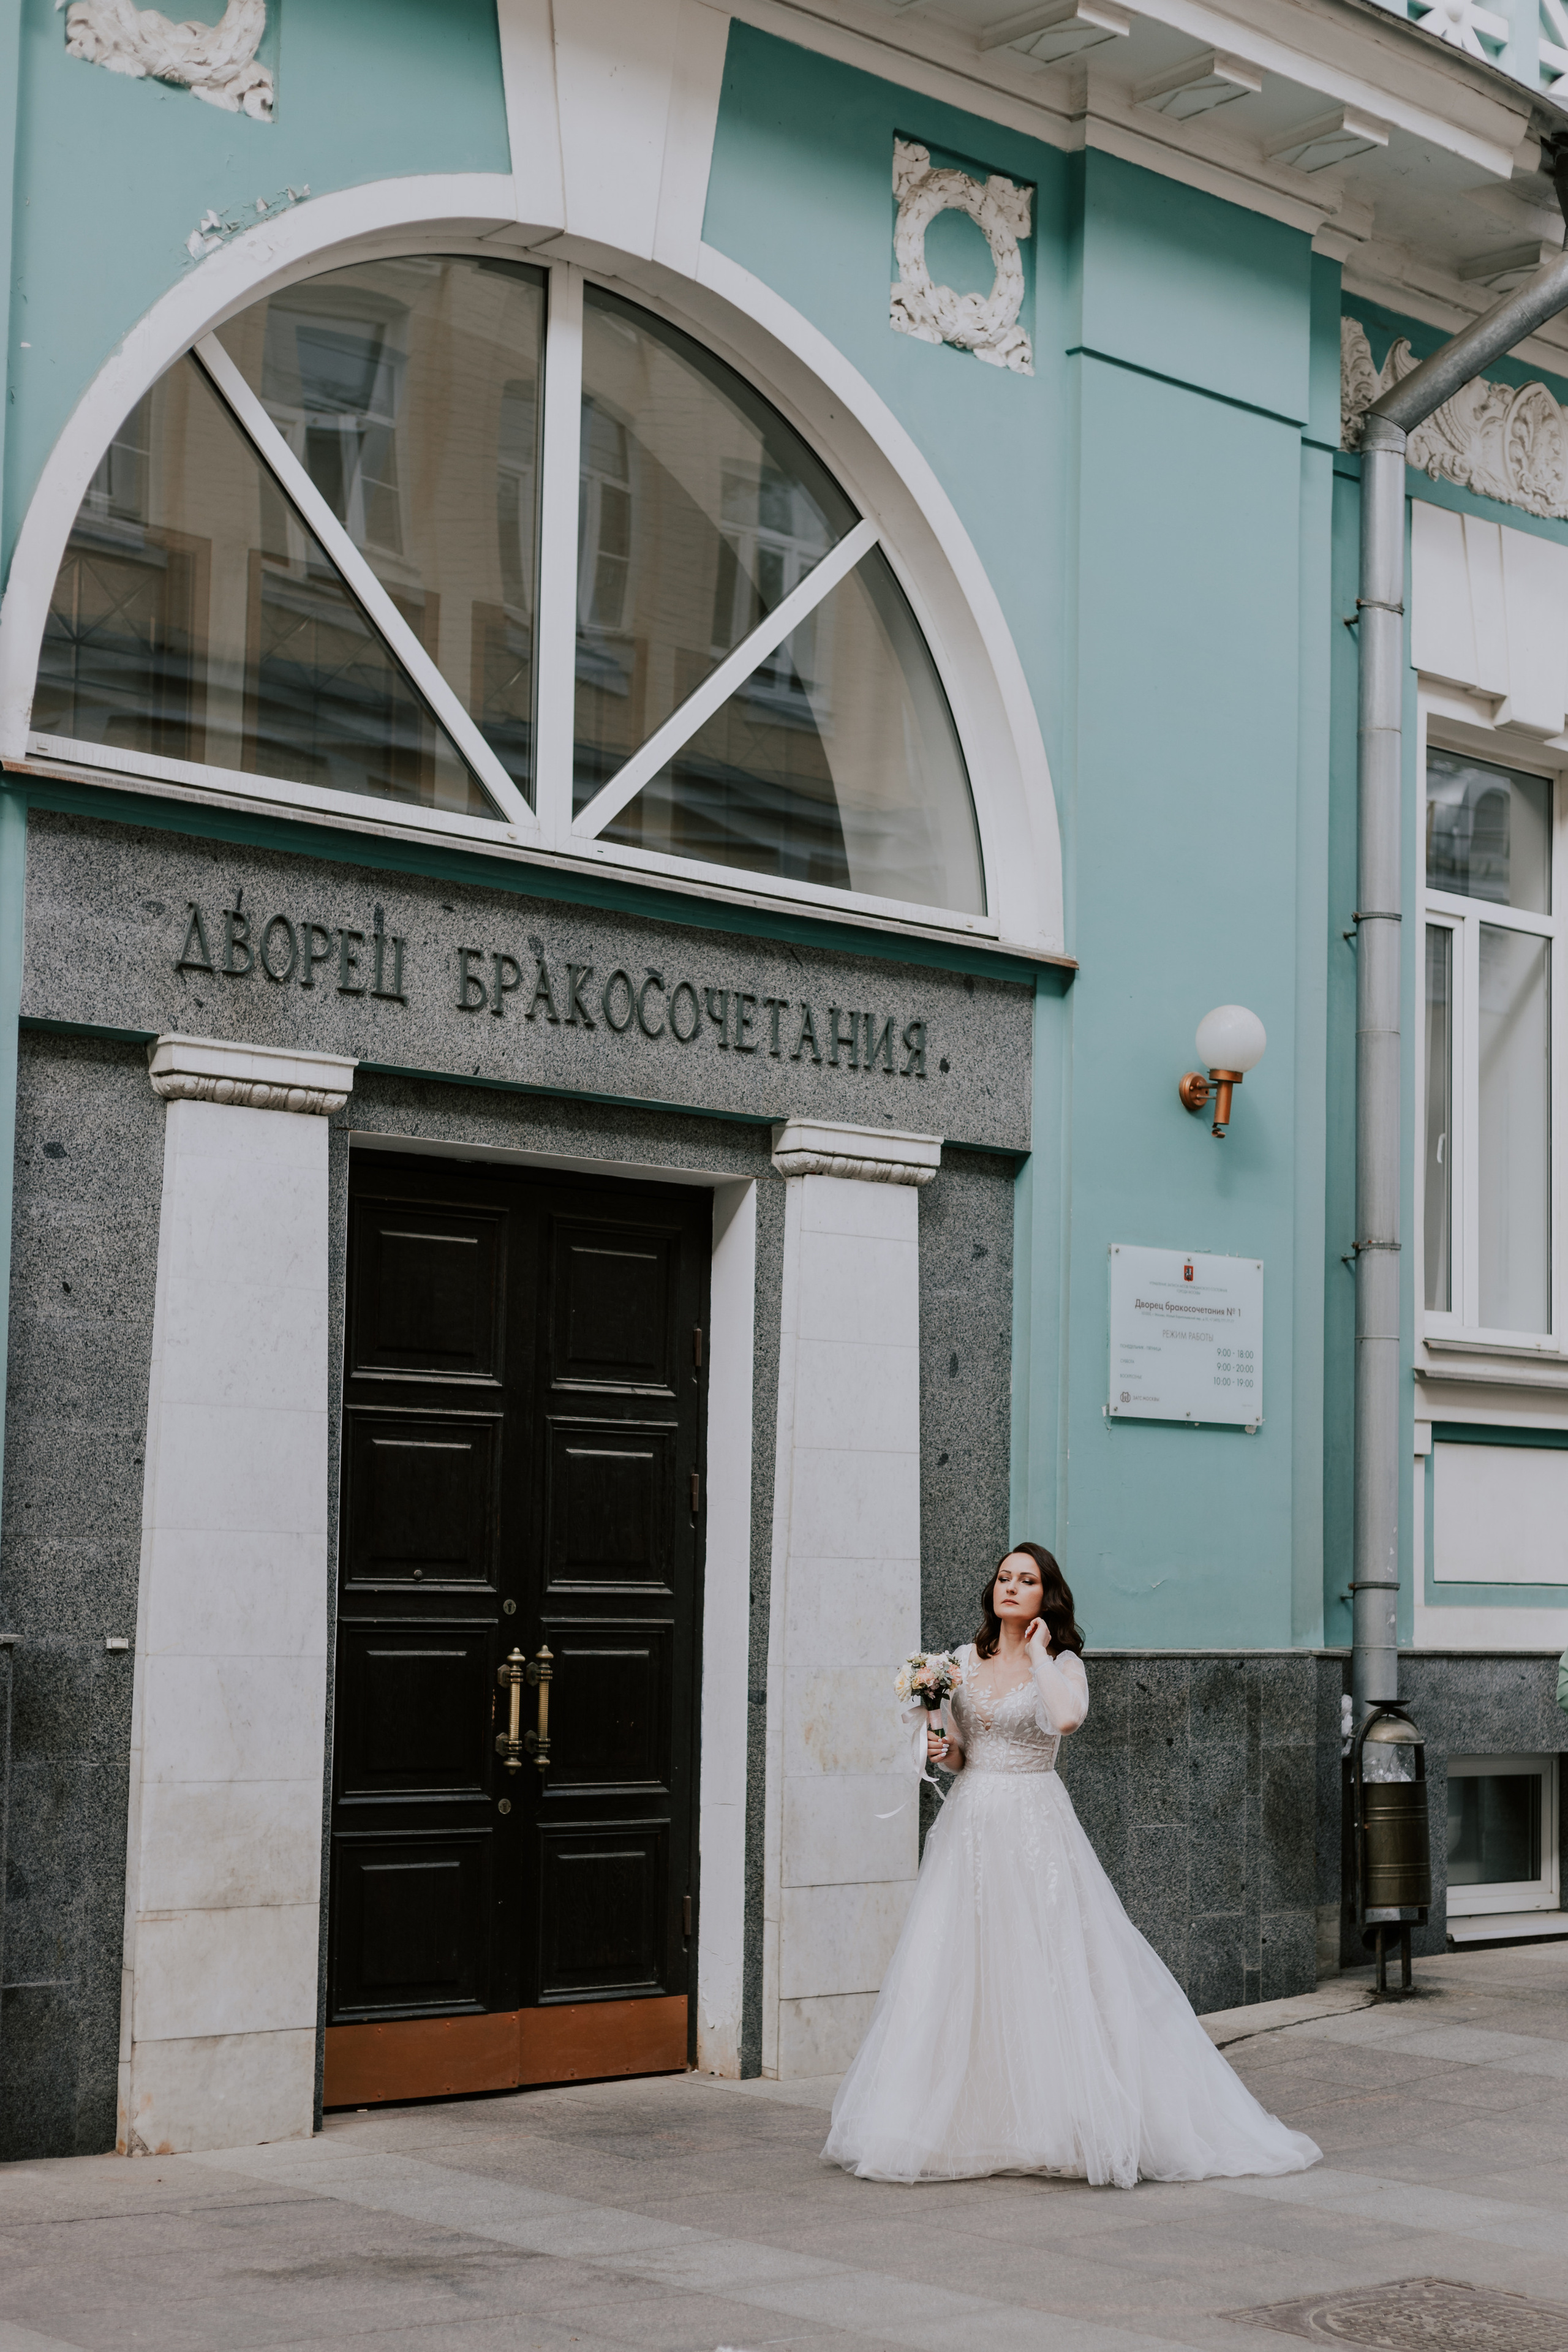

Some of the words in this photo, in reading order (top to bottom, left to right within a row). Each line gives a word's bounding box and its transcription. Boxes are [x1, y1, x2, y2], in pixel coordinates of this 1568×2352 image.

[174, 900, 407, 1006] ДВОРЕЦ
[456, 946, 927, 1077] БРАКОСОЧЕТАНИЯ
[1135, 1298, 1164, 1311] Дворец
[1165, 1301, 1225, 1316] бракосочетания
[1163, 1329, 1186, 1339] РЕЖИМ
[1188, 1332, 1214, 1342] РАБОТЫ
[1216, 1348, 1231, 1357] 9:00
[1237, 1349, 1254, 1359] 18:00
[1216, 1362, 1231, 1371] 9:00
[1236, 1363, 1254, 1373] 20:00
[1213, 1376, 1231, 1386] 10:00
[1237, 1378, 1254, 1388] 19:00
